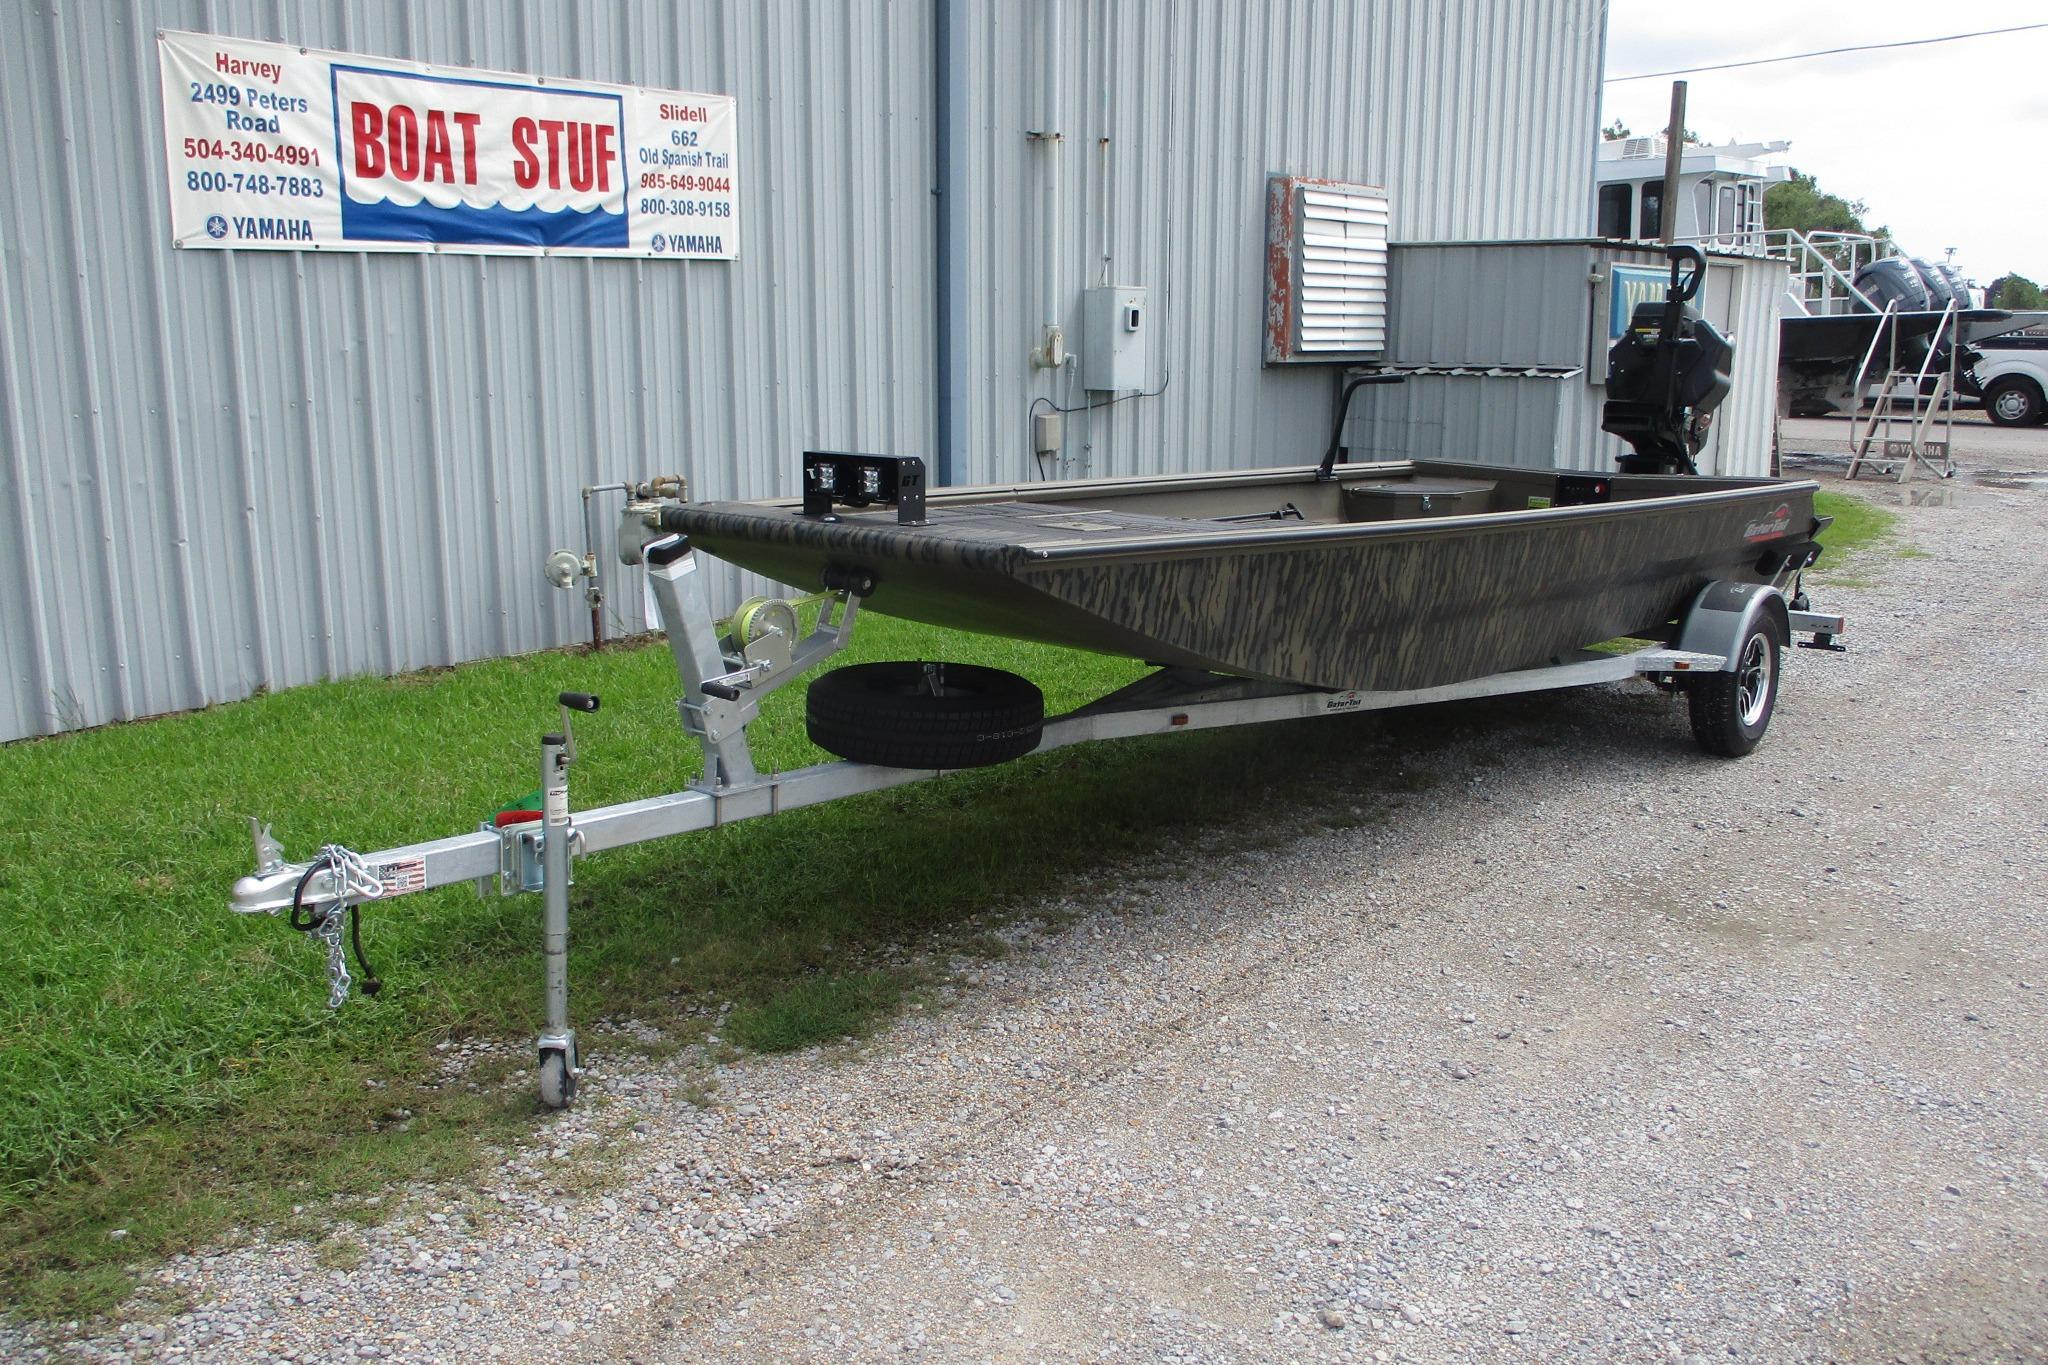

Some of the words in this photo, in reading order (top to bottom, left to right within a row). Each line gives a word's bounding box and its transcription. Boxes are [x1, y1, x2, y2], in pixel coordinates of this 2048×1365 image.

[215, 52, 281, 83] Harvey
[190, 82, 241, 105] 2499
[247, 88, 308, 113] Peters
[226, 110, 280, 133] Road
[659, 104, 708, 123] Slidell
[351, 101, 481, 185] BOAT
[512, 116, 616, 192] STUF
[671, 130, 698, 147] 662
[184, 138, 320, 167] 504-340-4991
[639, 148, 660, 165] Old
[662, 149, 702, 169] Spanish
[705, 152, 729, 169] Trail
[187, 171, 324, 198] 800-748-7883
[641, 173, 731, 193] 985-649-9044
[641, 199, 731, 217] 800-308-9158
[233, 217, 313, 241] YAMAHA
[669, 235, 722, 254] YAMAHA
